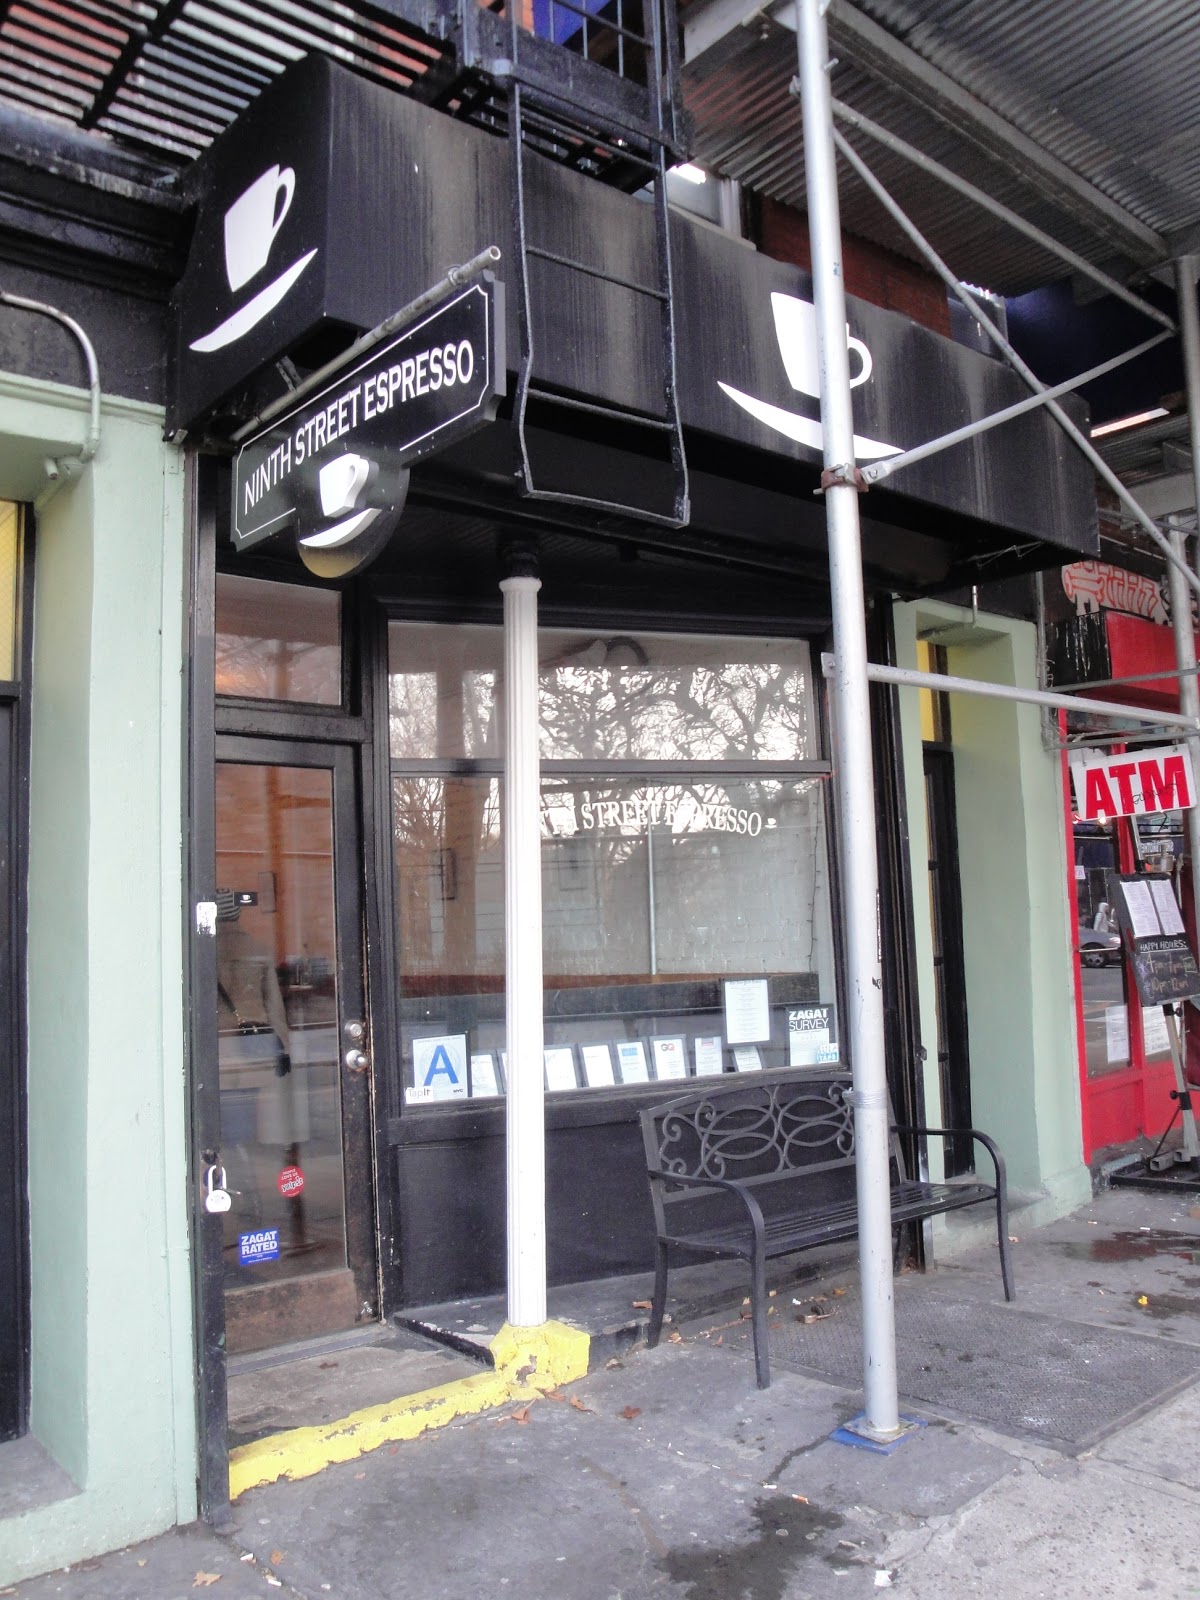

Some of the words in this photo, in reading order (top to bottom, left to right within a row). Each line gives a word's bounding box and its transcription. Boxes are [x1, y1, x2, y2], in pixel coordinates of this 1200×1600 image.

[244, 437, 292, 515] NINTH
[295, 384, 362, 466] STREET
[363, 339, 474, 421] ESPRESSO
[1085, 755, 1191, 820] ATM
[581, 800, 661, 829] STREET
[1140, 941, 1158, 951] HAPPY
[789, 1008, 829, 1021] ZAGAT
[789, 1017, 829, 1031] SURVEY
[660, 1043, 675, 1052] GQ
[423, 1044, 459, 1087] A
[241, 1230, 277, 1245] ZAGAT
[241, 1240, 278, 1255] RATED
